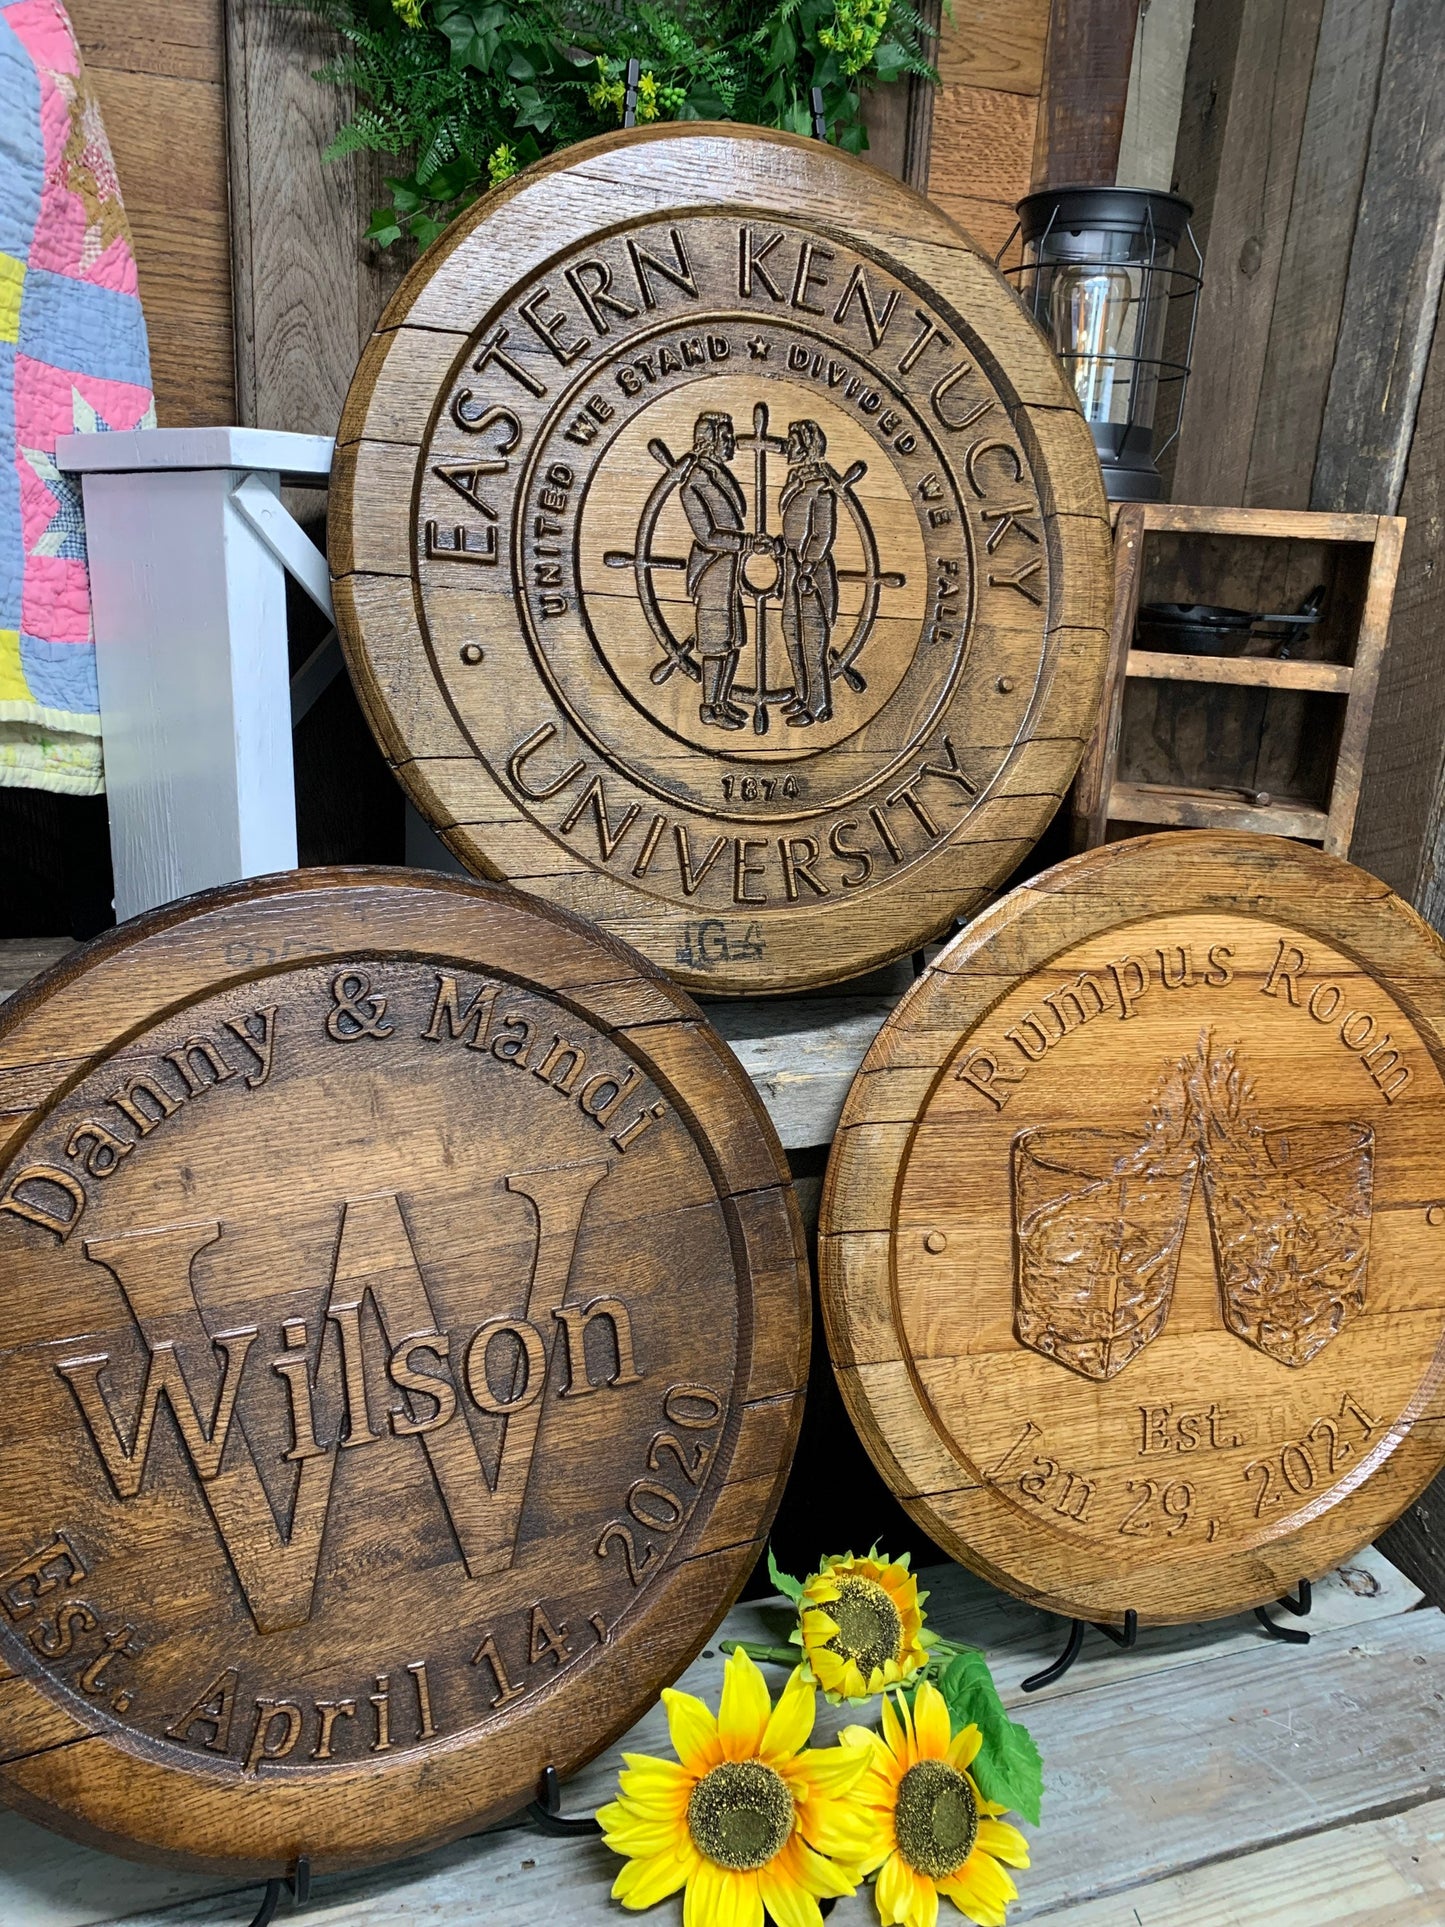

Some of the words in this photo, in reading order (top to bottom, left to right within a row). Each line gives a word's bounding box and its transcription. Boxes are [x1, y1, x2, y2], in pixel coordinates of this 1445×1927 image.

[424, 227, 702, 566] EASTERN
[739, 226, 1045, 607] KENTUCKY
[565, 394, 614, 446] WE
[617, 334, 732, 399] STAND
[787, 346, 920, 456] DIVIDED
[533, 459, 576, 621] UNITED
[915, 470, 955, 530] WE
[927, 557, 962, 647] FALL
[506, 721, 981, 905] UNIVERSITY
[720, 772, 800, 802] 1874
[954, 938, 1236, 1112] Rumpus
[1260, 936, 1417, 1106] Room
[2, 1003, 280, 1244] Danny
[325, 967, 395, 1043] &
[419, 970, 667, 1153] Mandi
[54, 1285, 644, 1500] Wilson
[82, 1158, 610, 1636] W
[982, 1419, 1100, 1524] Jan
[1117, 1476, 1223, 1543] 29,
[1242, 1390, 1388, 1517] 2021
[1136, 1402, 1247, 1456] Est.
[0, 1530, 134, 1713] Est.
[164, 1660, 440, 1777] April
[469, 1601, 616, 1708] 14,
[595, 1381, 724, 1588] 2020
